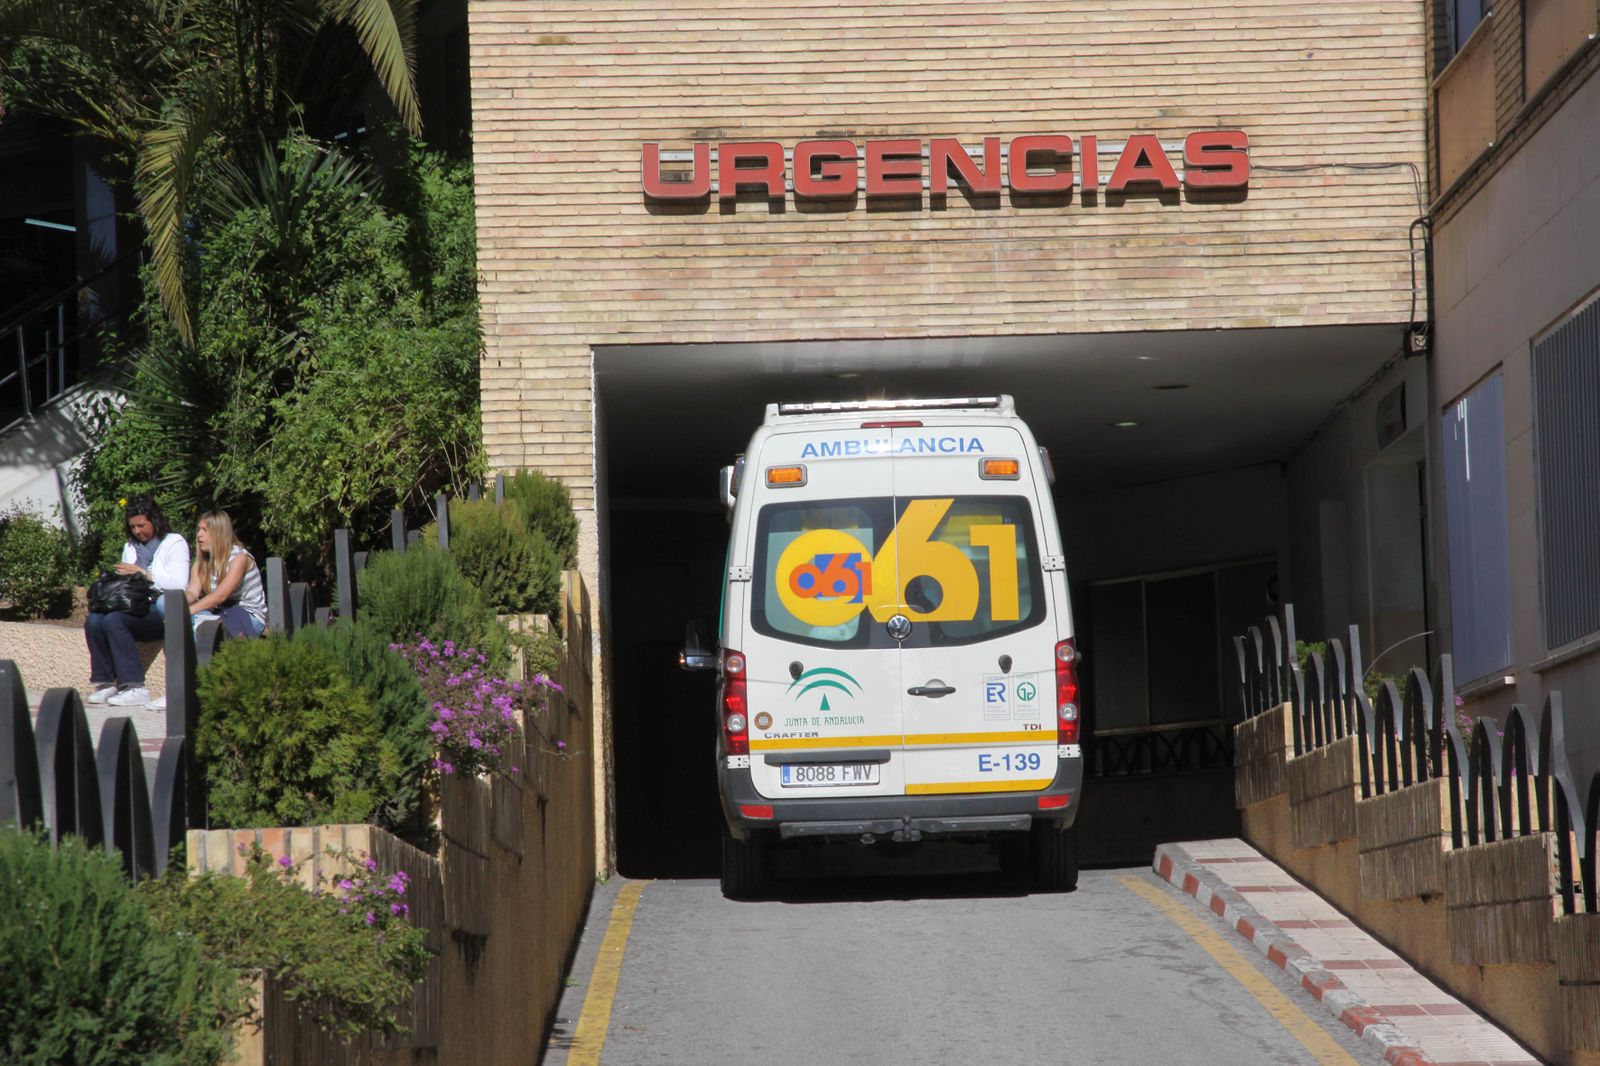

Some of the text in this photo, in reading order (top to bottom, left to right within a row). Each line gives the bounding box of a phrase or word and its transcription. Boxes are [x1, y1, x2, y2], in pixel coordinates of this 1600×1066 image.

[642, 131, 1250, 200] URGENCIAS
[801, 437, 984, 458] AMBULANCIA
[784, 717, 808, 727] JUNTA
[811, 716, 821, 726] DE
[824, 715, 865, 726] ANDALUCIA
[1023, 723, 1042, 731] TDI
[764, 731, 819, 739] CRAFTER
[978, 752, 1041, 772] E-139
[796, 764, 872, 782] 8088 FWV
